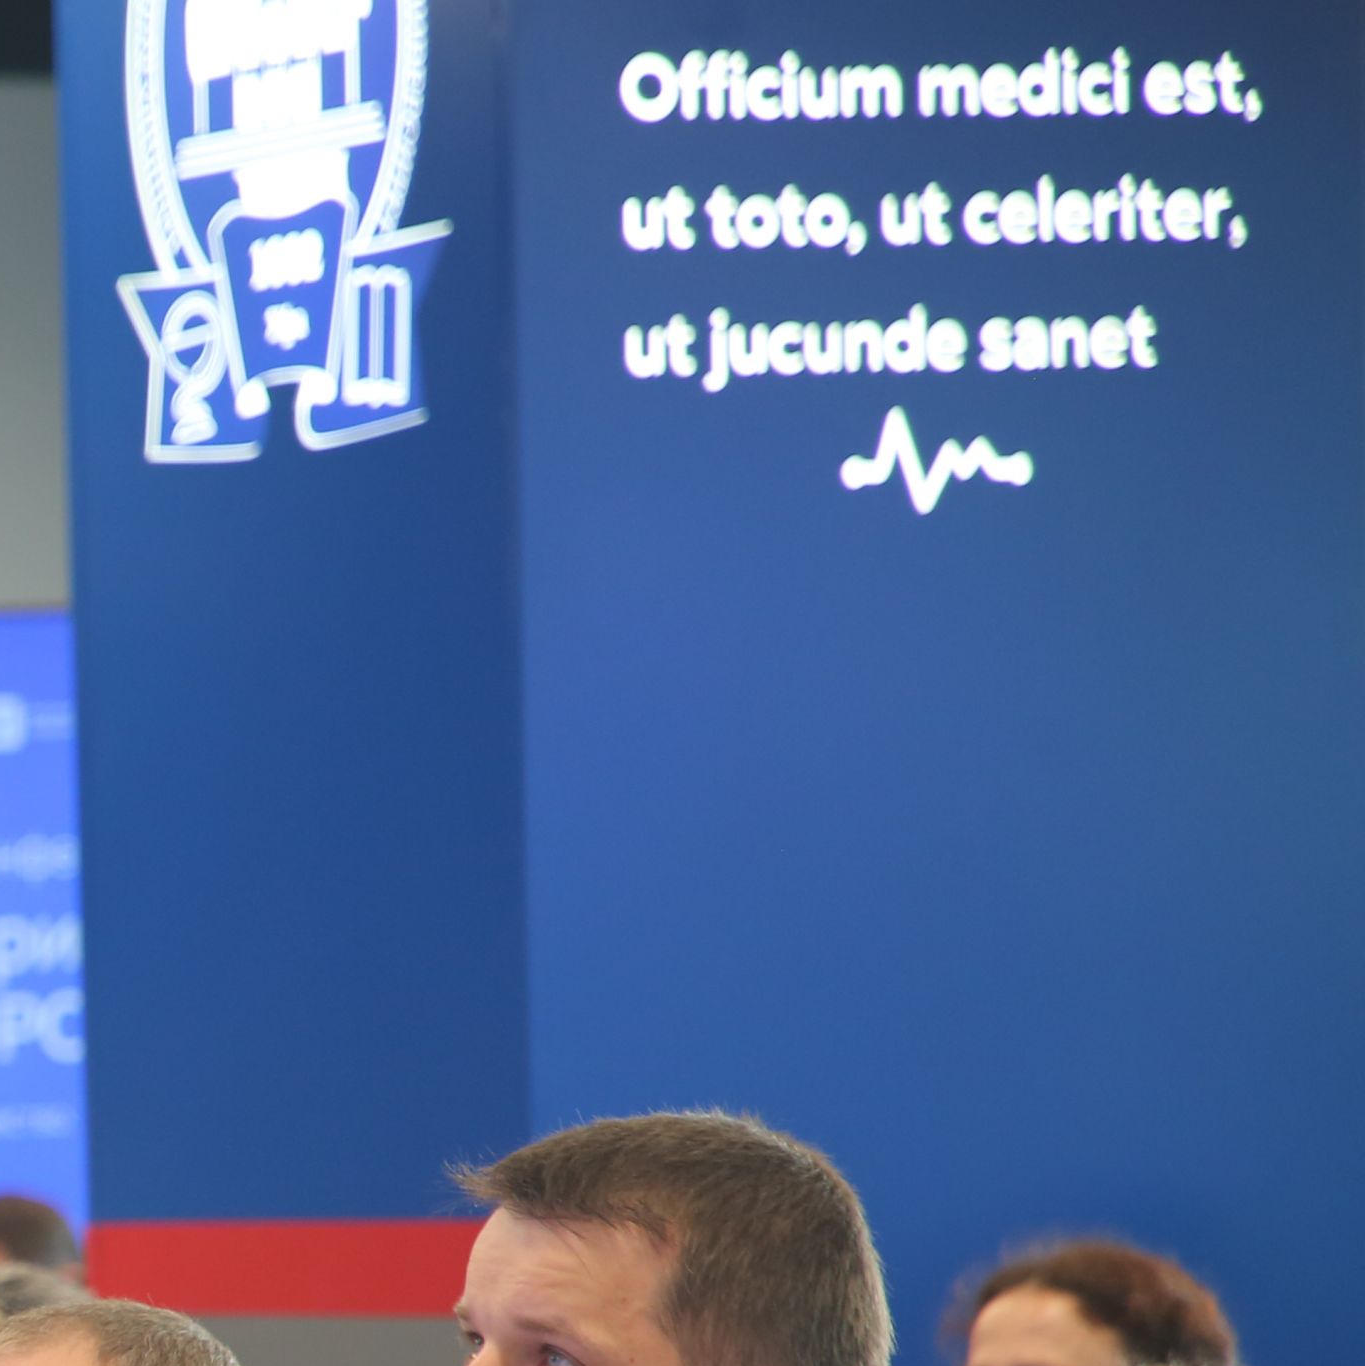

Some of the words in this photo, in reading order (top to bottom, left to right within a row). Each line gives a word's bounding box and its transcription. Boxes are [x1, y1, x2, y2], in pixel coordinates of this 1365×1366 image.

[620, 50, 903, 122] Officium
[918, 46, 1130, 118] medici
[1143, 50, 1262, 122] est,
[622, 186, 696, 250] ut
[705, 184, 867, 256] toto,
[880, 181, 953, 246] ut
[963, 173, 1248, 249] celeriter,
[625, 314, 698, 378] ut
[702, 303, 968, 393] jucunde
[980, 305, 1158, 373] sanet
